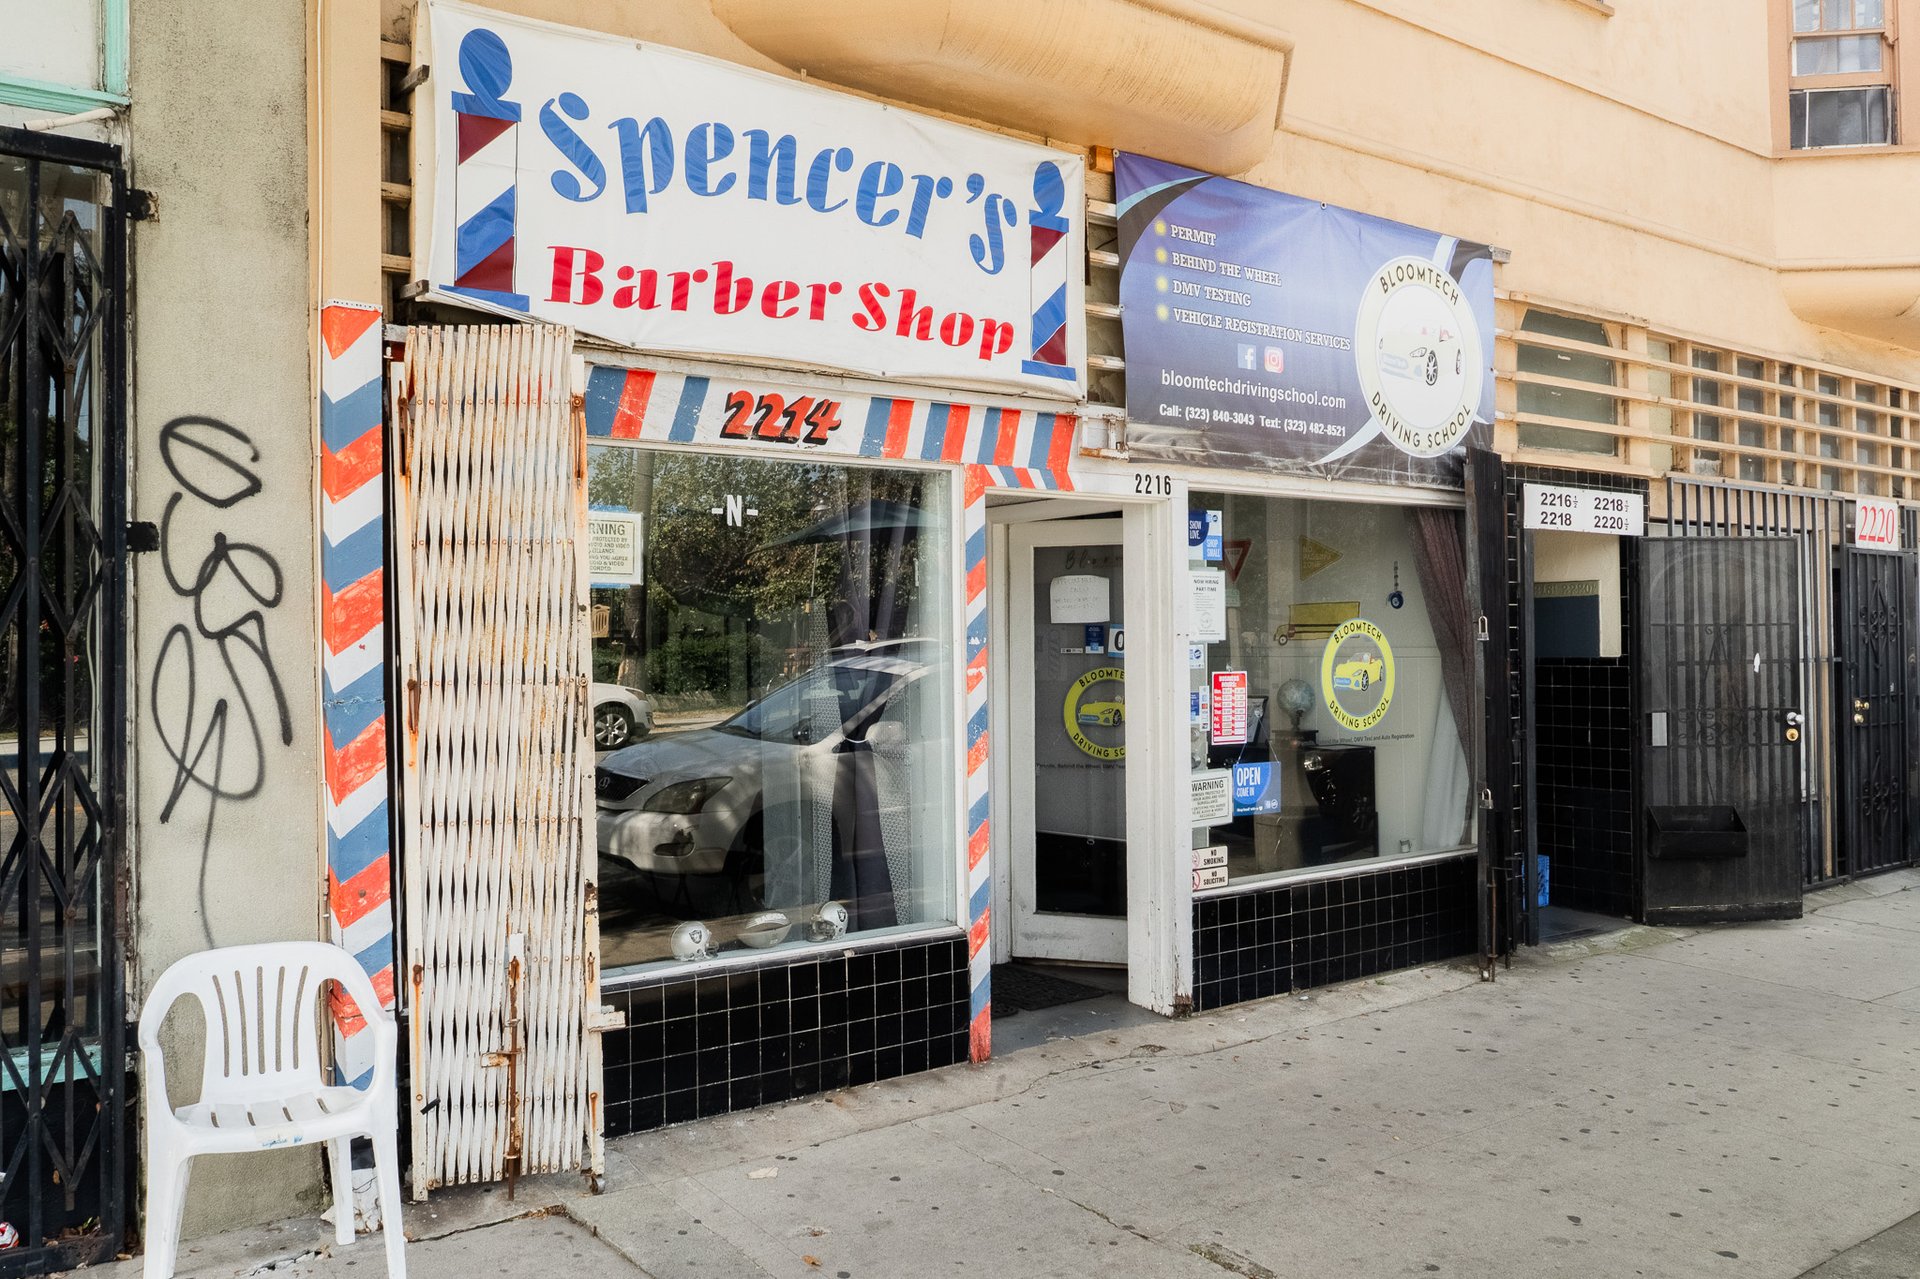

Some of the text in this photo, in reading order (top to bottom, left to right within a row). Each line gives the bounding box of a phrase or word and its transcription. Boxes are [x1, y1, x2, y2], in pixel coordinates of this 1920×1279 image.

[539, 92, 1017, 275] Spencer's
[1170, 224, 1216, 247] PERMIT
[1172, 252, 1282, 287] BEHIND THE WHEEL
[1172, 280, 1252, 306] DMV TESTING
[1380, 264, 1459, 306] BLOOMTECH
[544, 245, 1015, 361] Barber Shop
[1173, 308, 1351, 351] VEHICLE REGISTRATION SERVICES
[1161, 369, 1346, 409] bloomtechdrivingschool.com
[719, 390, 842, 445] 2214
[1159, 404, 1346, 437] Call: (323) 840-3043 Text: (323) 482-8521
[1372, 391, 1471, 449] DRIVING SCHOOL
[1135, 473, 1171, 495] 2216
[589, 522, 625, 535] RNING
[1189, 520, 1202, 529] SHOW
[1540, 511, 1572, 526] 2218
[1858, 506, 1895, 544] 2220
[1206, 539, 1218, 548] SHOP
[1206, 548, 1220, 557] SMALL
[1334, 622, 1382, 643] BLOOMTECH
[1078, 669, 1124, 687] BLOOMTE
[1330, 697, 1390, 729] DRIVING SCHOOL
[1073, 733, 1110, 758] DRIVING
[1191, 780, 1224, 792] WARNING
[1236, 766, 1261, 786] OPEN
[1236, 787, 1255, 797] COME IN
[1203, 857, 1224, 866] SMOKING
[1210, 849, 1217, 857] NO
[1203, 876, 1225, 886] SOLICITING
